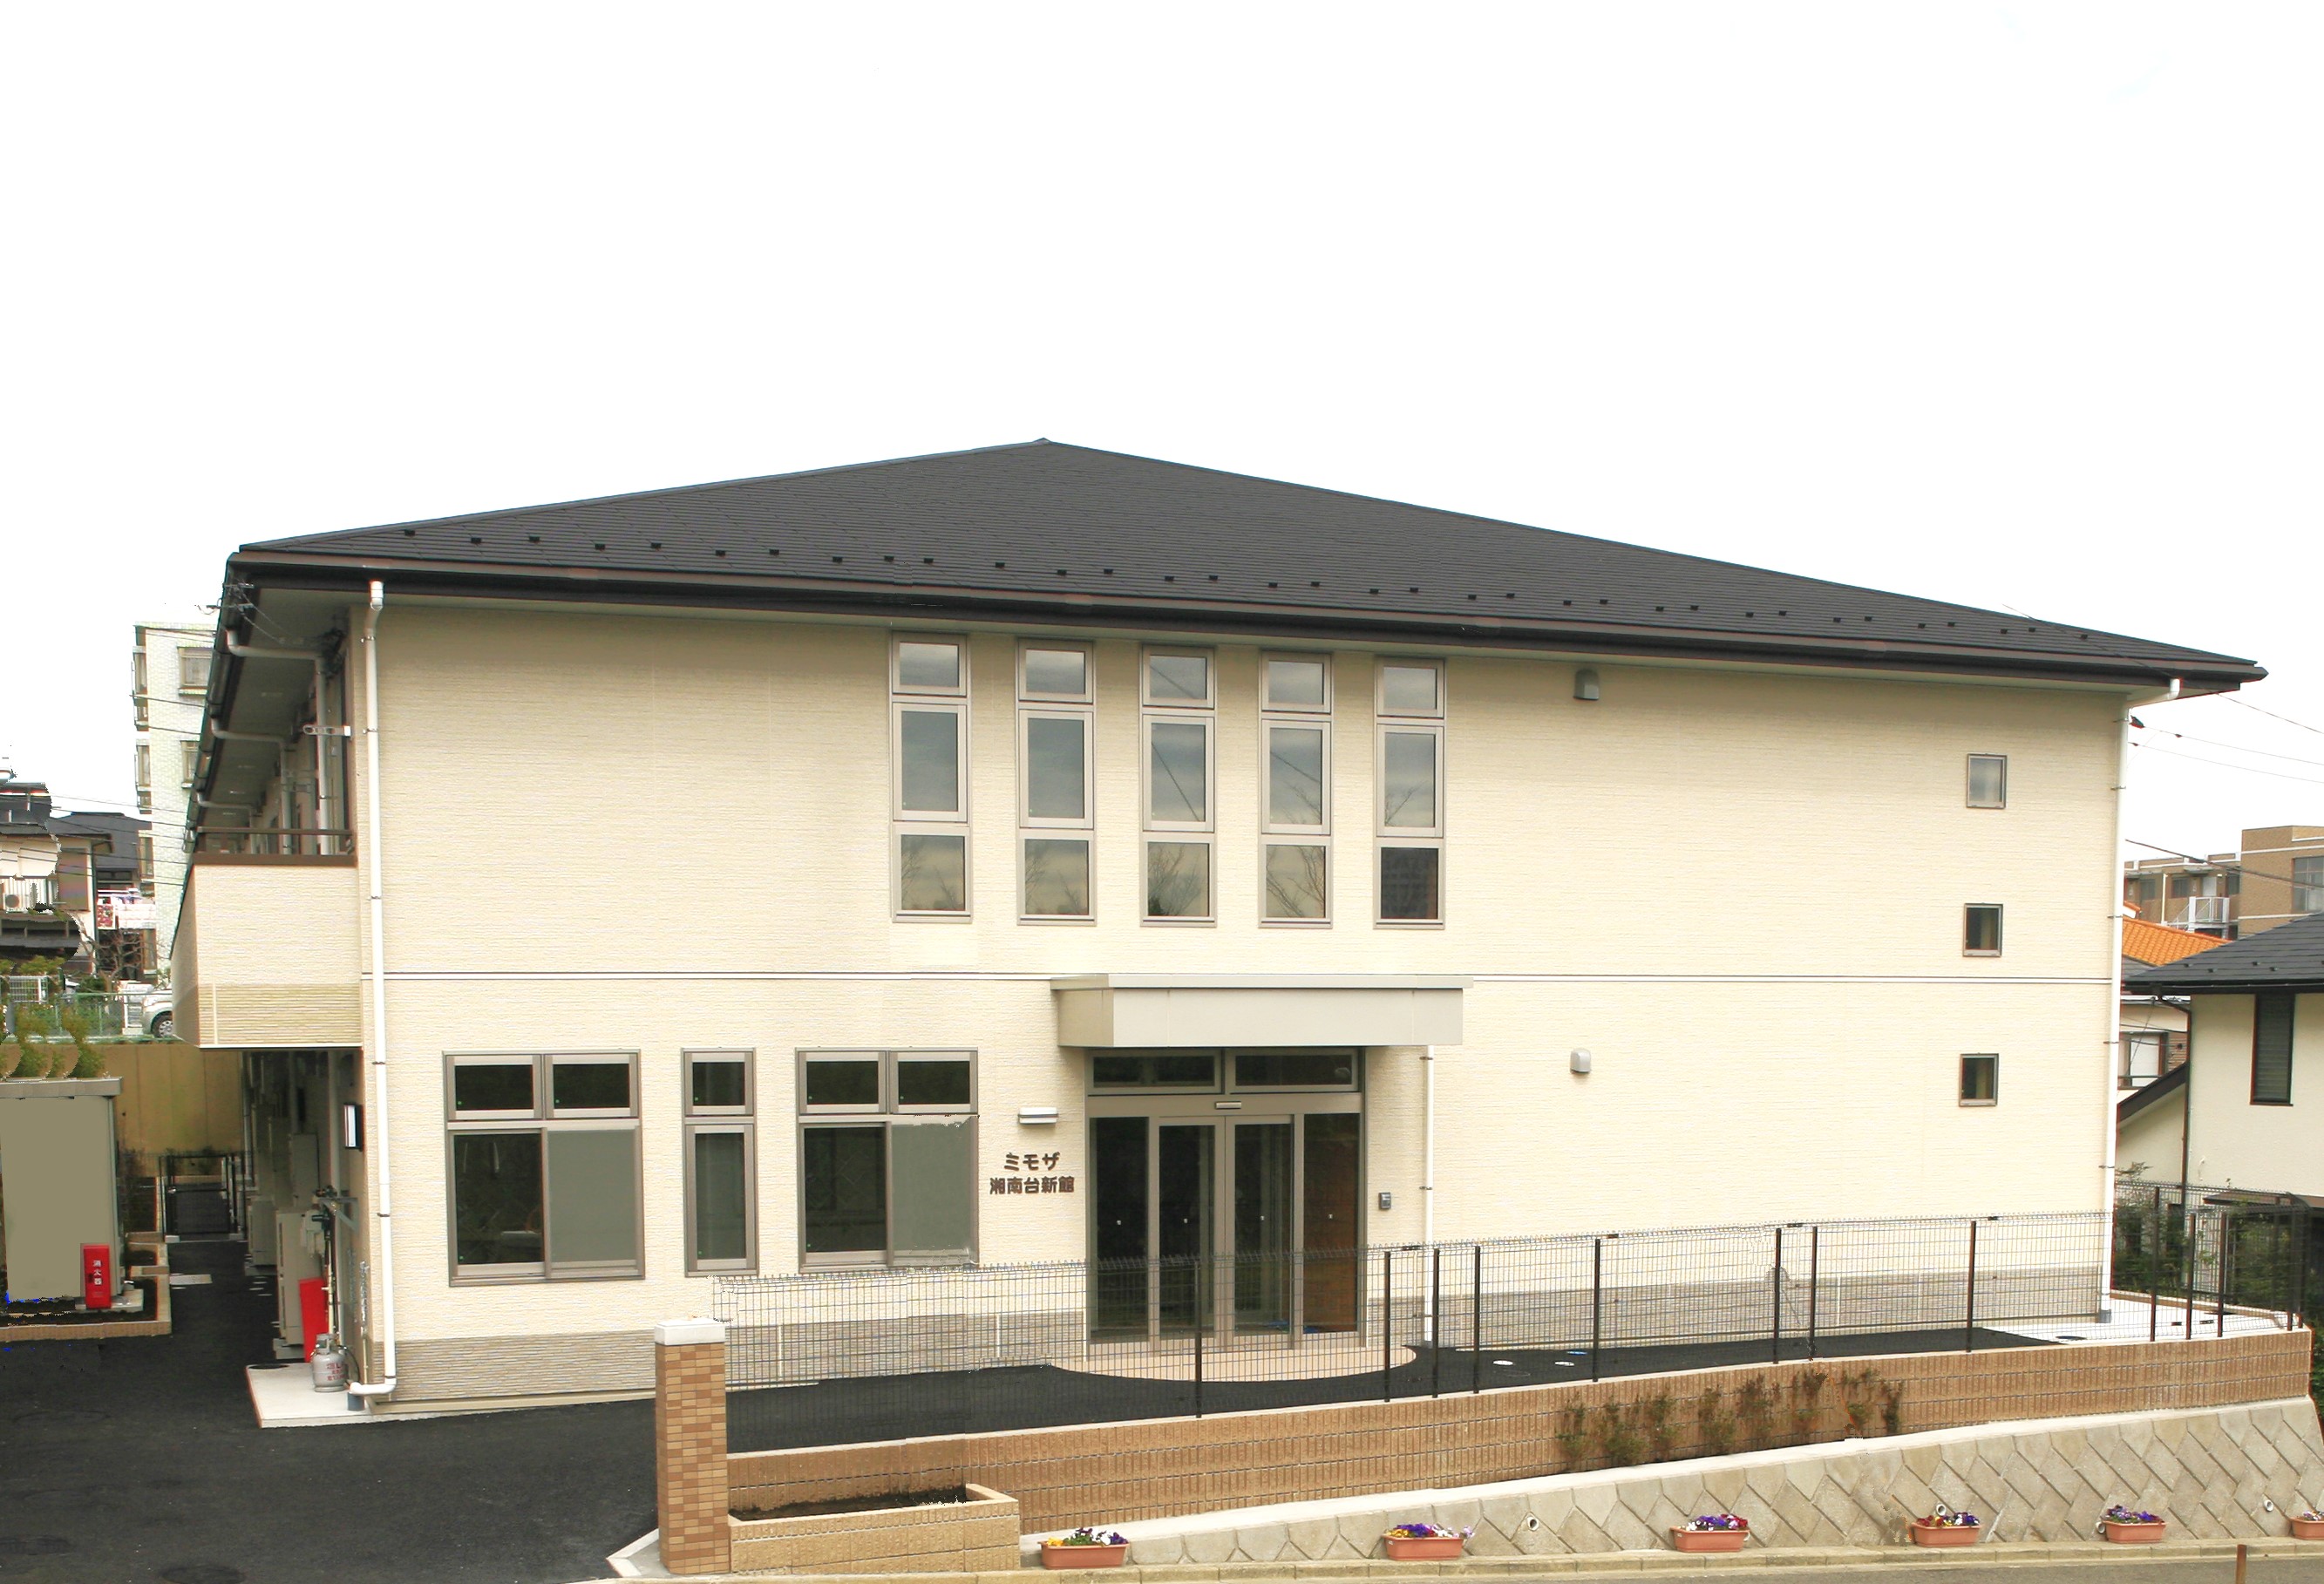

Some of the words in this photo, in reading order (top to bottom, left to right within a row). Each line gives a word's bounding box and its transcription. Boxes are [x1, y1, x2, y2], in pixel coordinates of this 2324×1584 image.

[1004, 1152, 1060, 1171] ミモザ
[989, 1176, 1075, 1194] 湘南台新館
